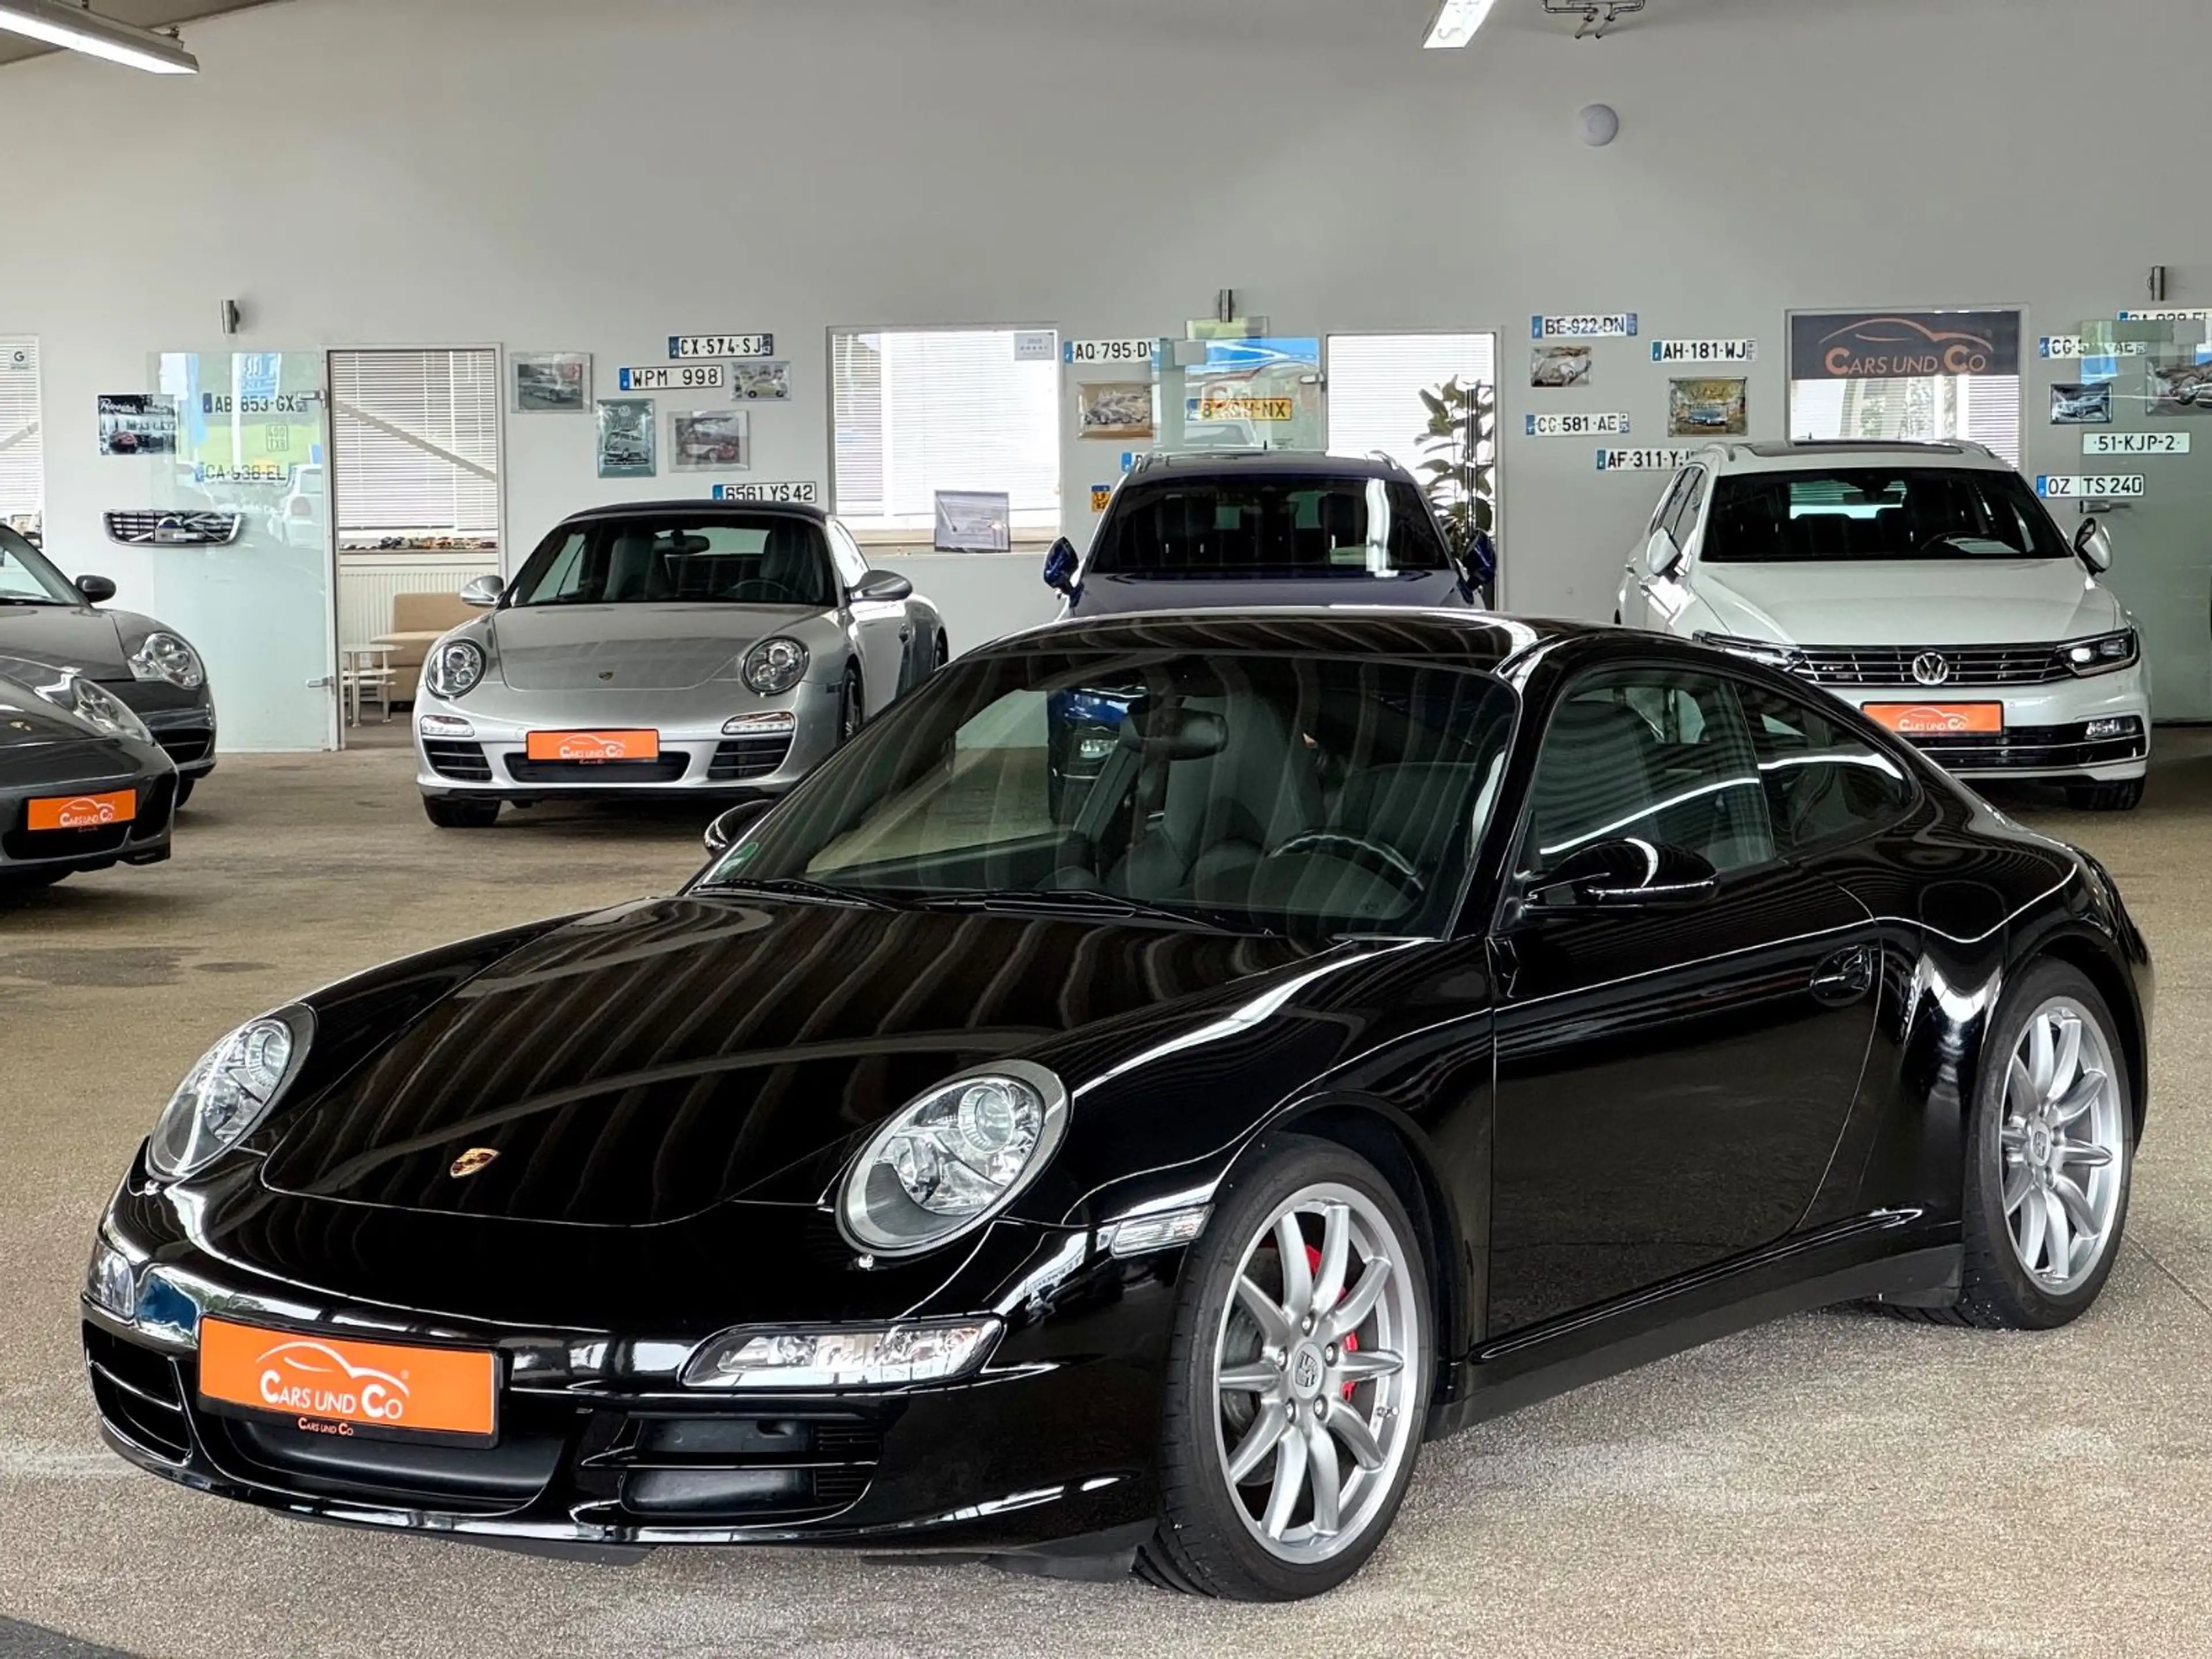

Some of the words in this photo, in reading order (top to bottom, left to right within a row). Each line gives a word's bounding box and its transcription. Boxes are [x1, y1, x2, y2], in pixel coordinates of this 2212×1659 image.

[1546, 317, 1624, 335] BE-922-DN
[681, 338, 761, 355] CX-574-SJ
[1663, 342, 1746, 359] AH-181-WJ
[632, 370, 668, 387] WPM
[682, 368, 718, 385] 998
[2097, 435, 2175, 451] 51-KJP-2
[725, 485, 763, 501] 6561
[770, 484, 790, 501] YS
[793, 484, 813, 501] 42
[2083, 478, 2105, 494] TS
[2109, 477, 2142, 494] 240
